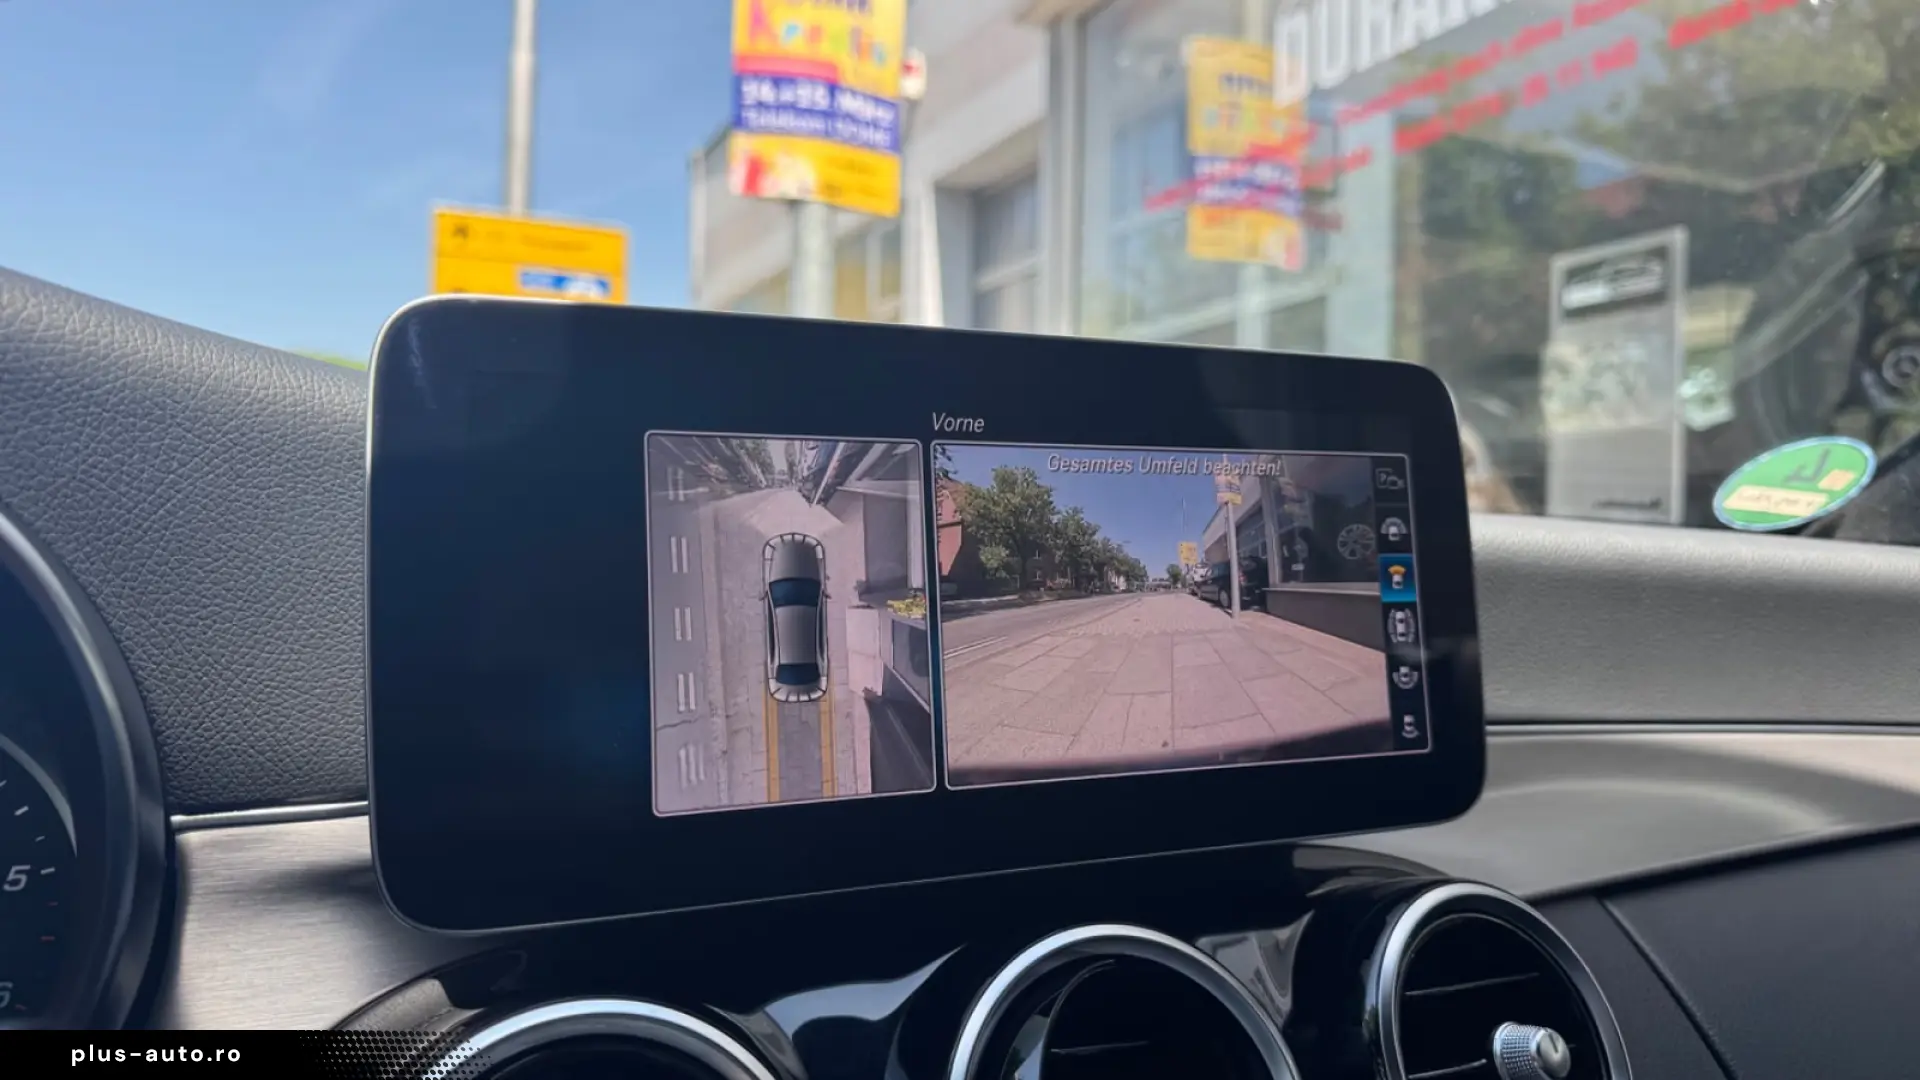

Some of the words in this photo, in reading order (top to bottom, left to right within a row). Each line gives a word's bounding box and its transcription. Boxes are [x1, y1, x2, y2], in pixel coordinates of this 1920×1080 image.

[932, 411, 985, 433] Vorne
[1048, 453, 1134, 474] Gesamtes
[1138, 456, 1199, 475] Umfeld
[1203, 458, 1282, 477] beachten!
[3, 864, 31, 891] 5
